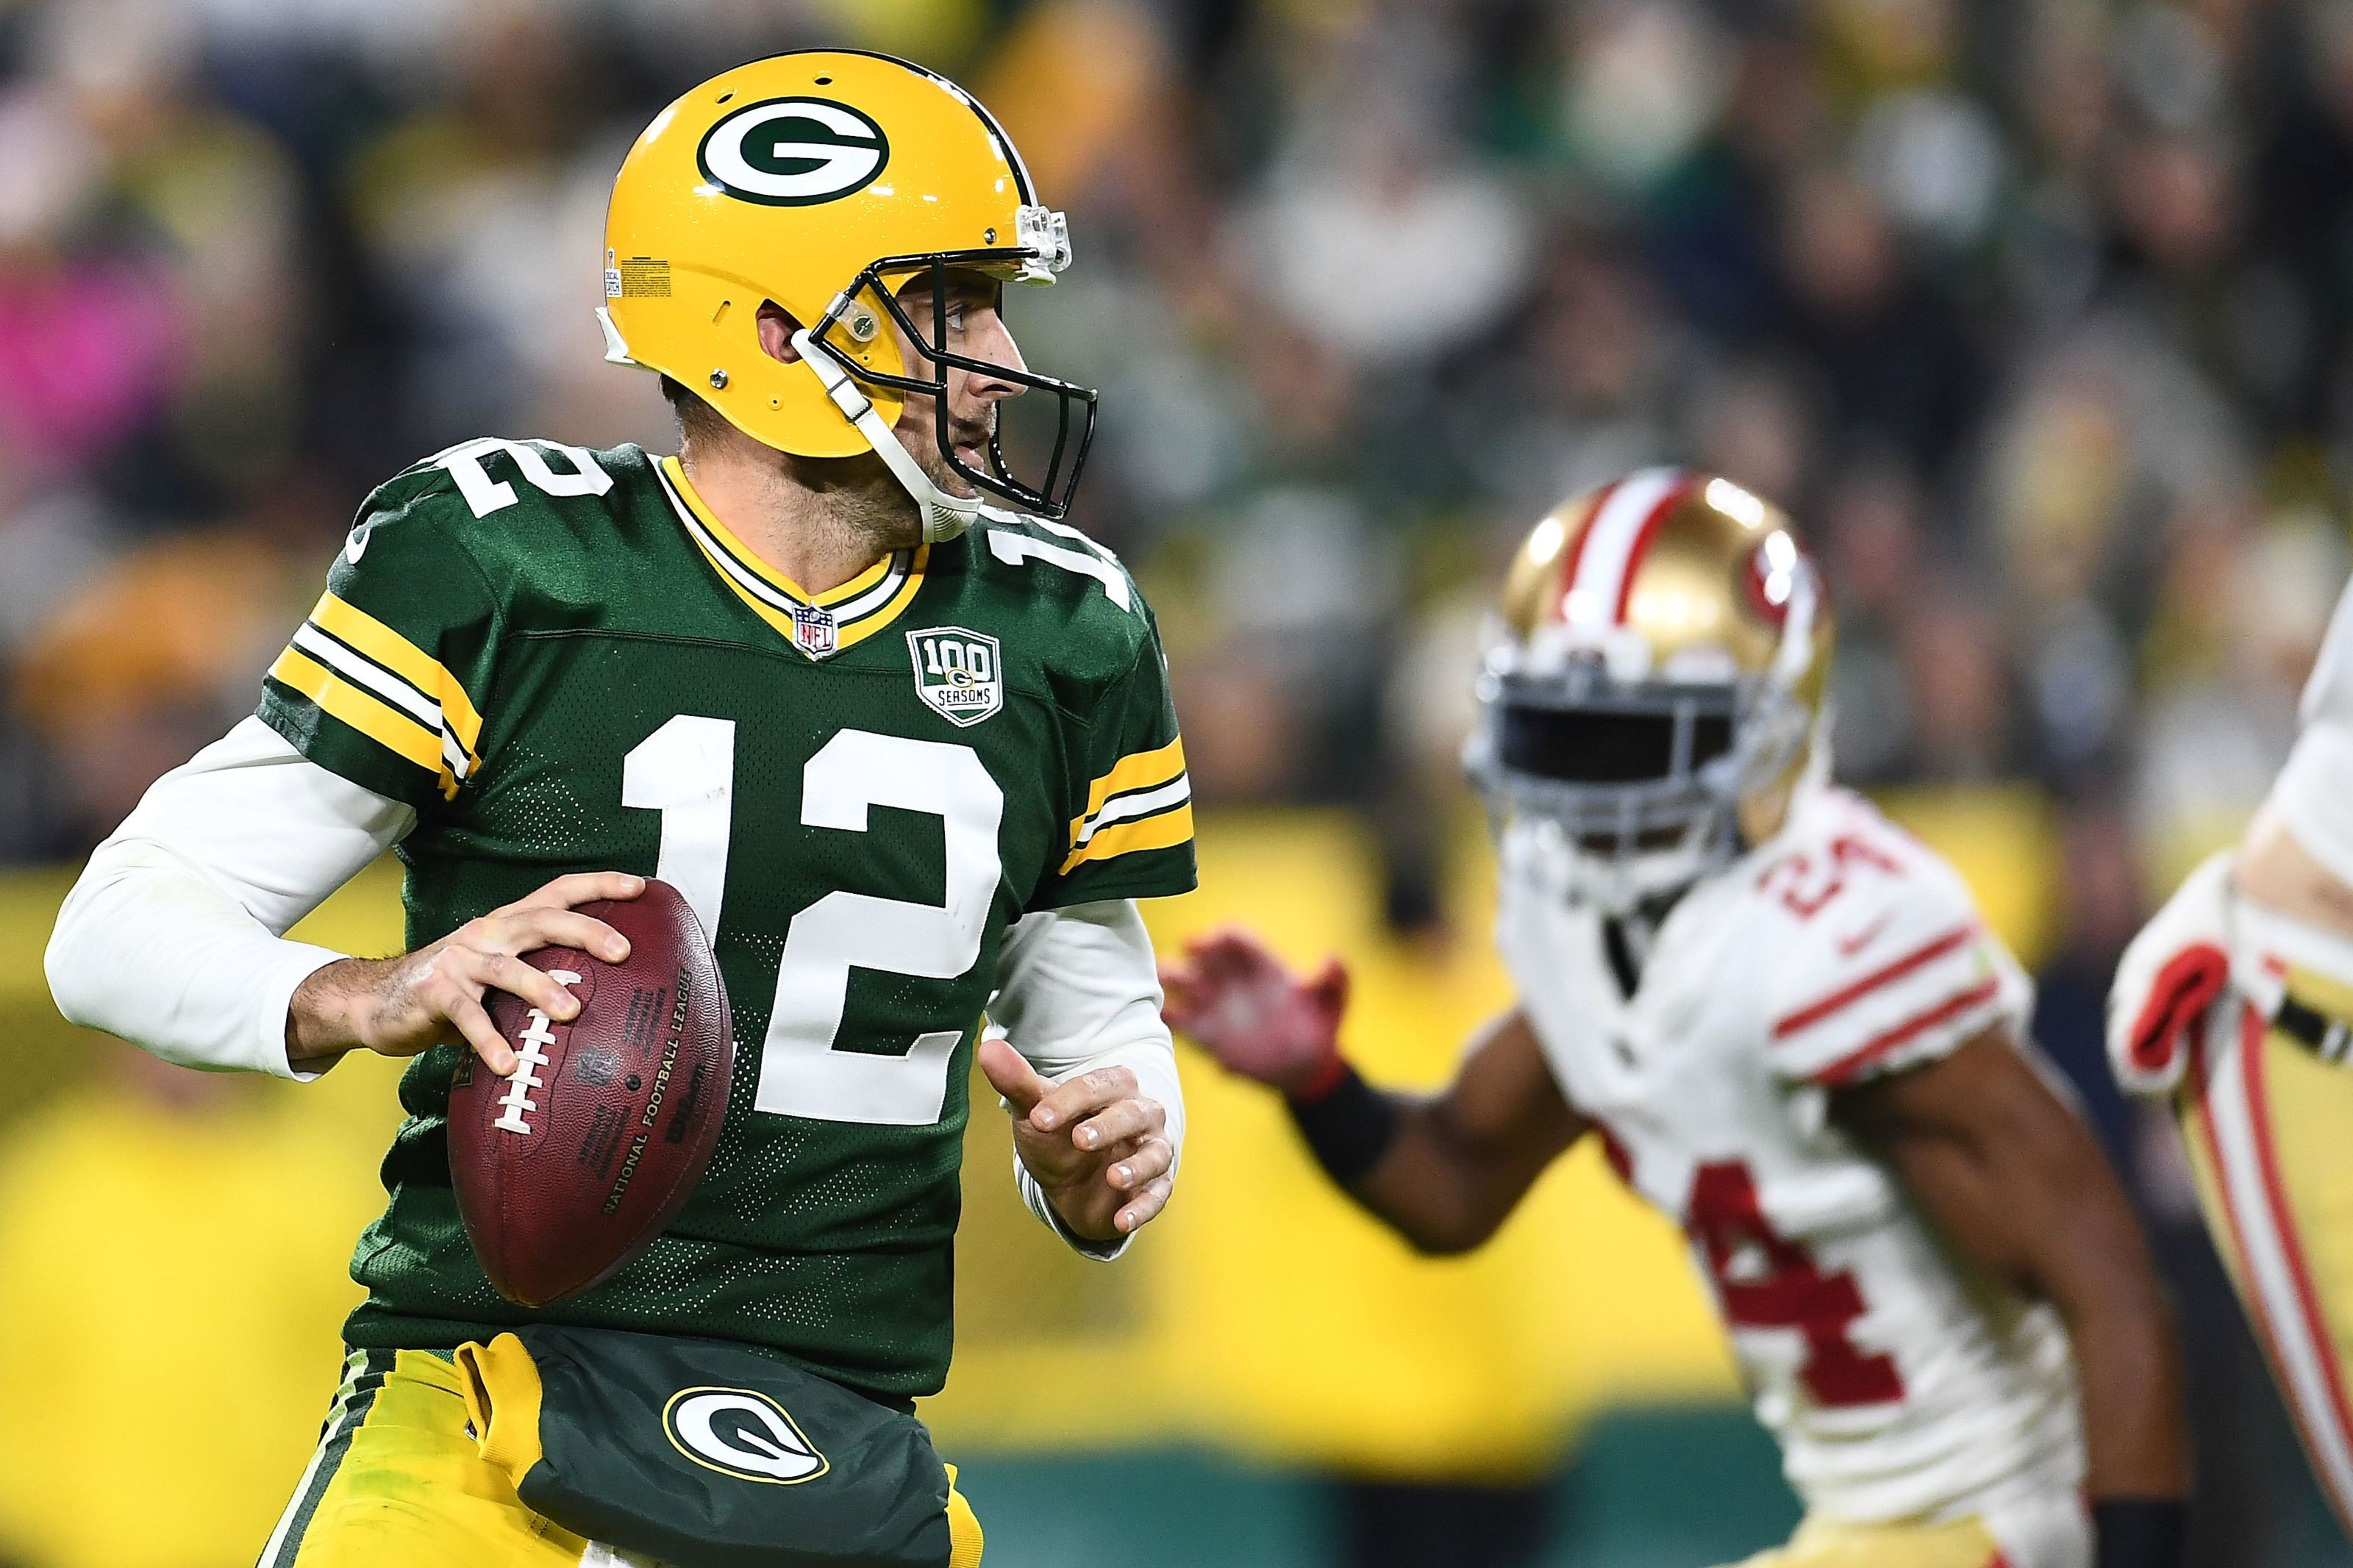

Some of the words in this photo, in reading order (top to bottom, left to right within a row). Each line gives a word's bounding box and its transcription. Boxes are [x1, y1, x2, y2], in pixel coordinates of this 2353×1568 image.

[704, 101, 882, 198] G
[799, 623, 831, 649] NFL
[924, 638, 991, 682] 100
[938, 688, 990, 706] SEASONS
[947, 668, 974, 688] G
[621, 714, 1004, 1125] 12
[604, 1134, 648, 1214] NATIONAL
[642, 1038, 679, 1128] FOOTBALL
[671, 969, 692, 1033] LEAGUE
[675, 1394, 818, 1478] G
